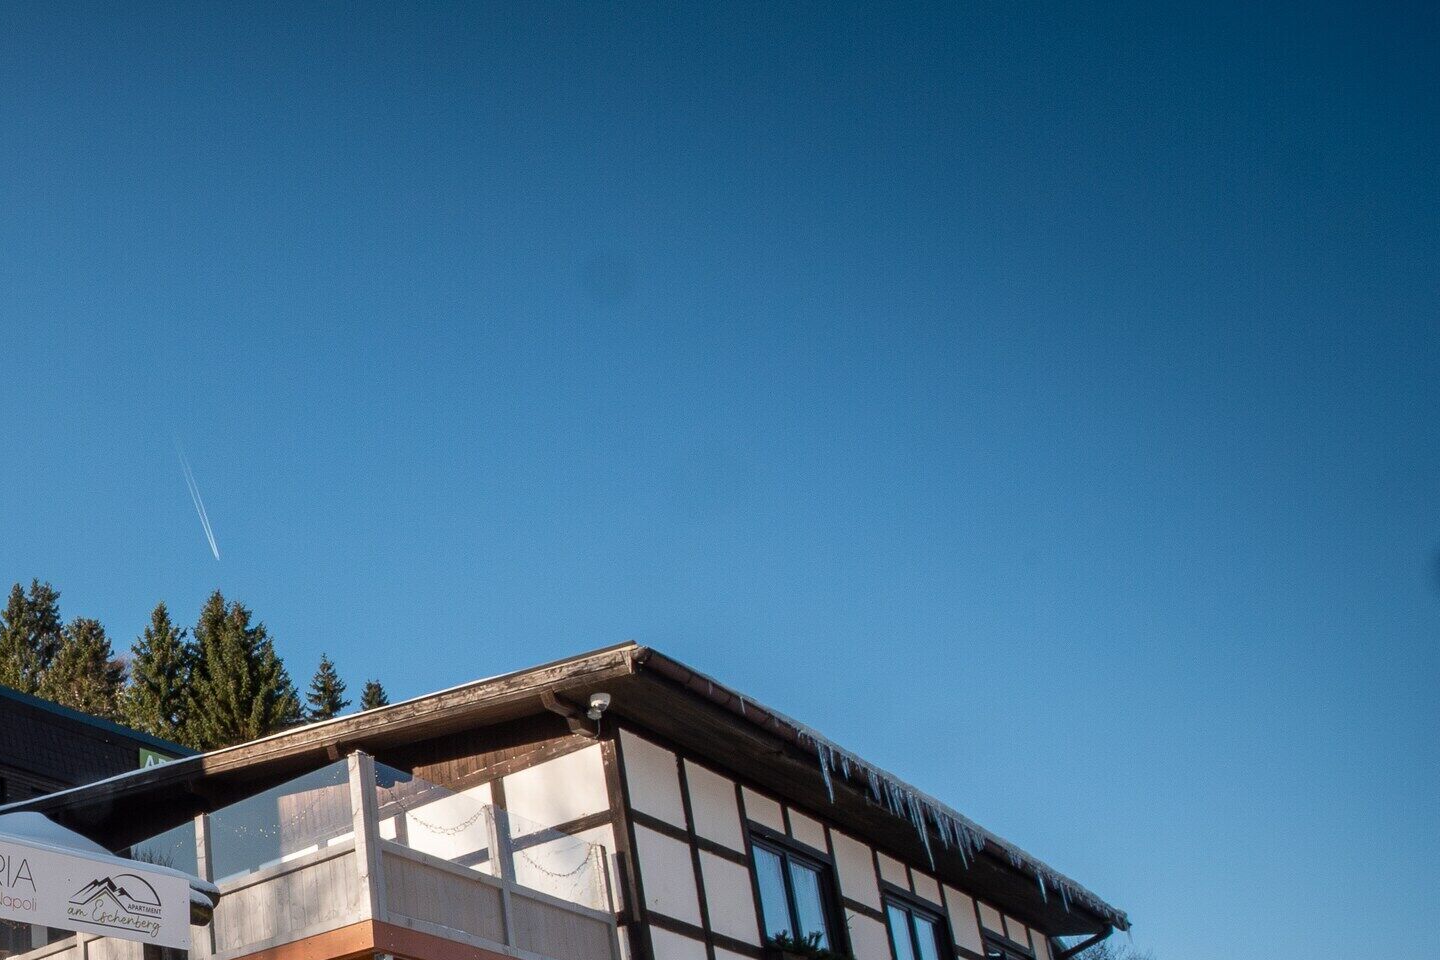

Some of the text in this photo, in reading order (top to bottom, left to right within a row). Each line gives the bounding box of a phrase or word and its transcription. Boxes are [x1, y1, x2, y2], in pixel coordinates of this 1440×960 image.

[67, 898, 162, 938] am Eschenberg
[127, 903, 162, 915] APARTMENT
